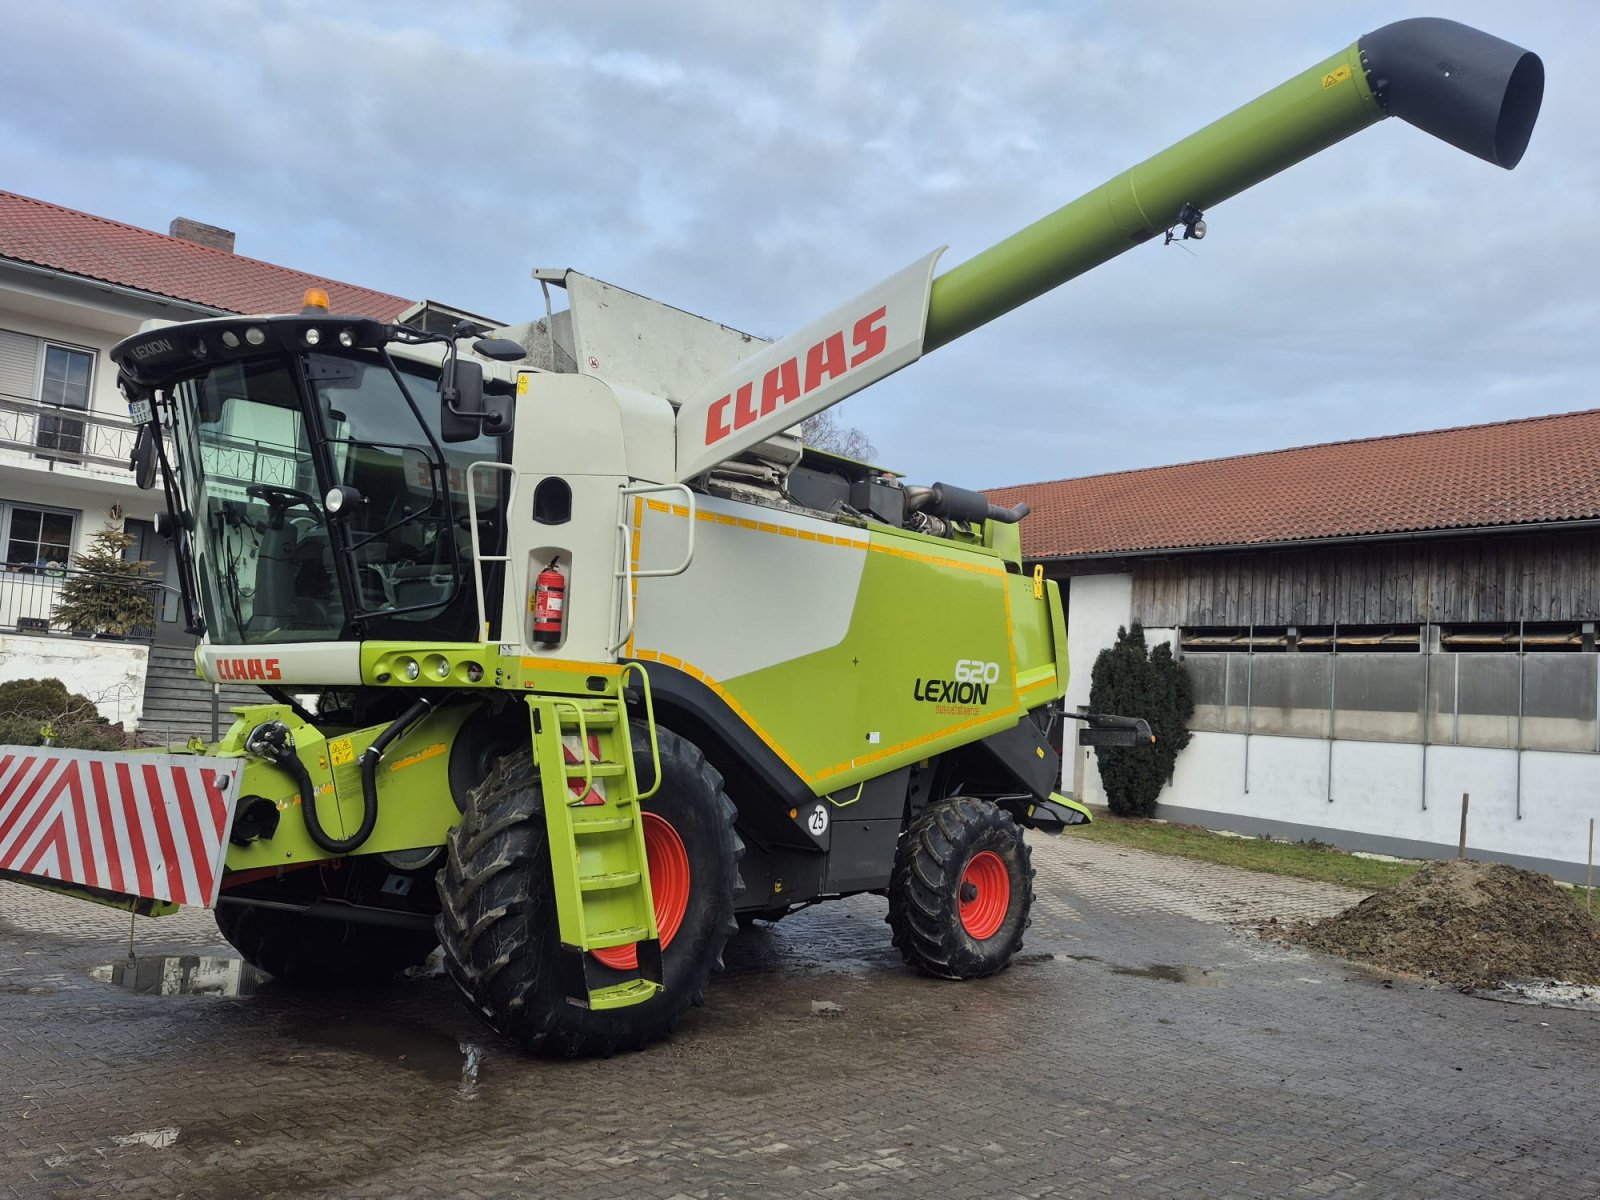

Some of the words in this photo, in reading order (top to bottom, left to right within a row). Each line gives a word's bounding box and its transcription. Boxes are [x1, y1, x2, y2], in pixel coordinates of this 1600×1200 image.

[130, 338, 174, 360] LEXION
[704, 304, 888, 447] CLAAS
[216, 659, 282, 680] CLAAS
[955, 659, 1000, 684] 620
[913, 677, 990, 705] LEXION
[812, 810, 824, 830] 25
